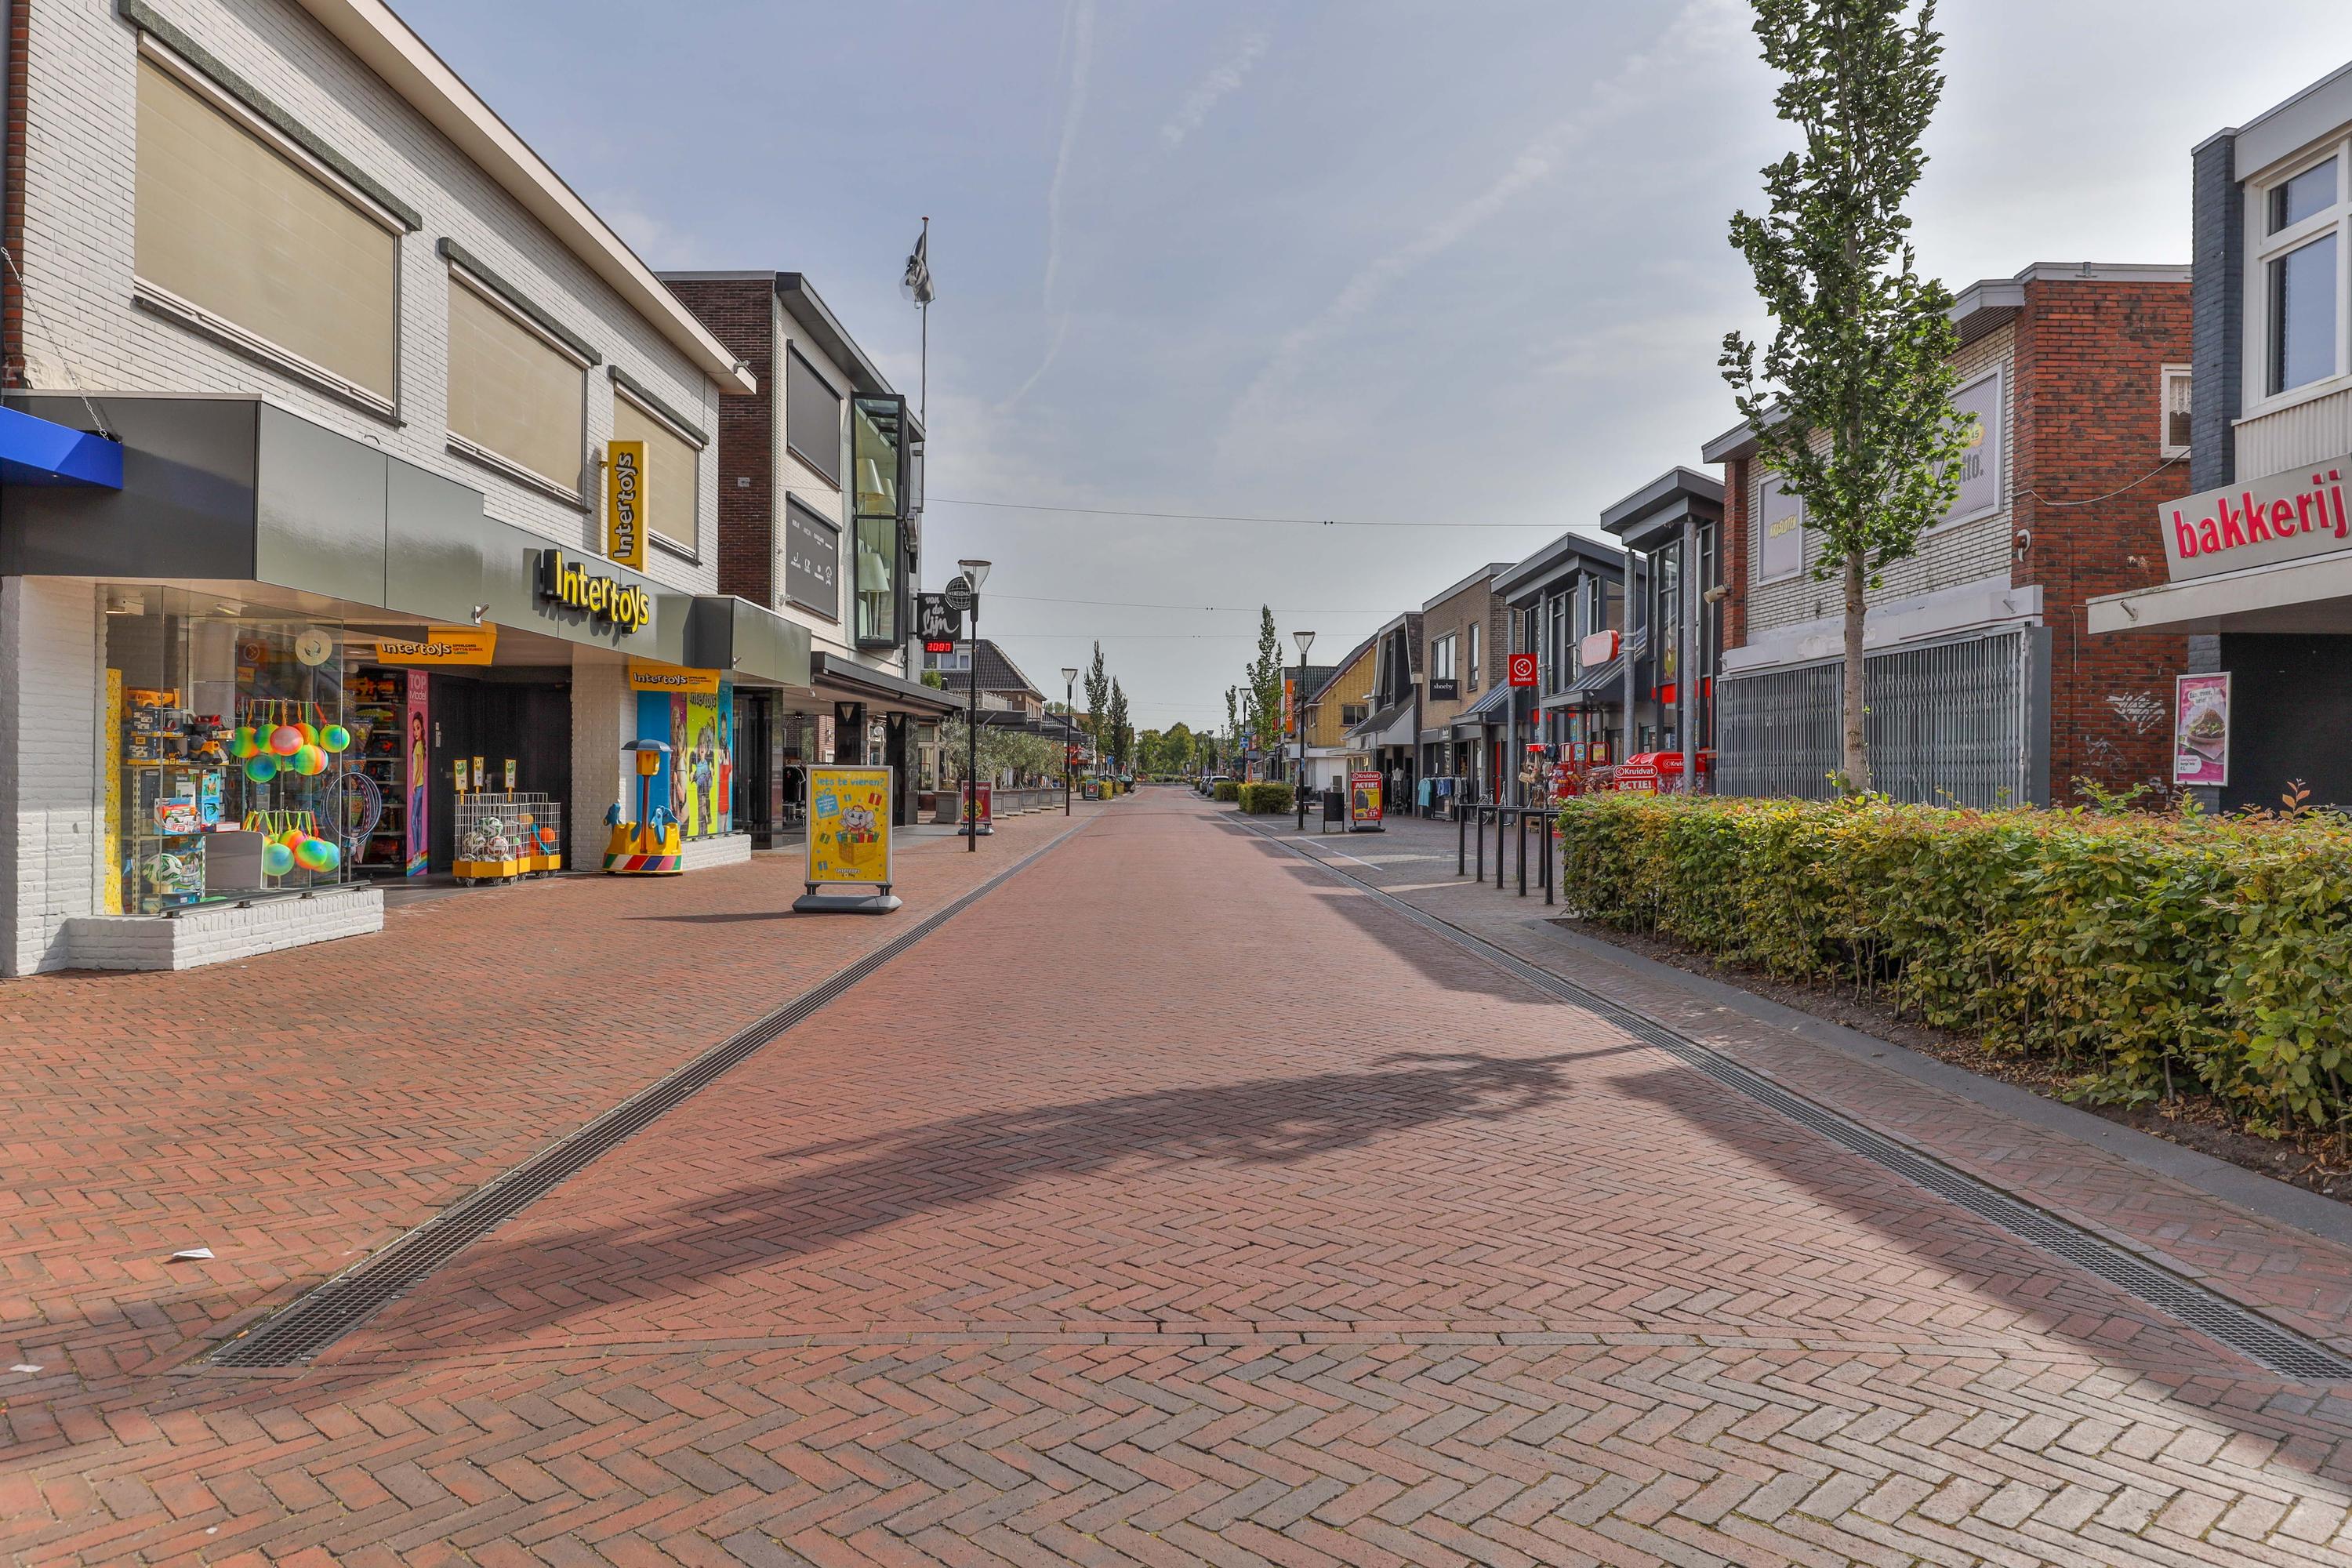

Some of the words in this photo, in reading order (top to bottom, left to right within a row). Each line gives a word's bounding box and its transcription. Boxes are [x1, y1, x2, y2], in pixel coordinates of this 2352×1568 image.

[613, 452, 639, 558] Intertoys
[2172, 469, 2349, 559] bakkerij
[555, 550, 650, 634] Intertoys
[925, 596, 941, 604] van
[931, 604, 945, 615] der
[382, 642, 452, 657] Intertoys
[409, 674, 426, 690] TOP
[633, 673, 688, 685] Intertoys
[409, 691, 426, 700] Model
[1619, 780, 1652, 789] ACTIE!
[964, 804, 982, 813] 5%
